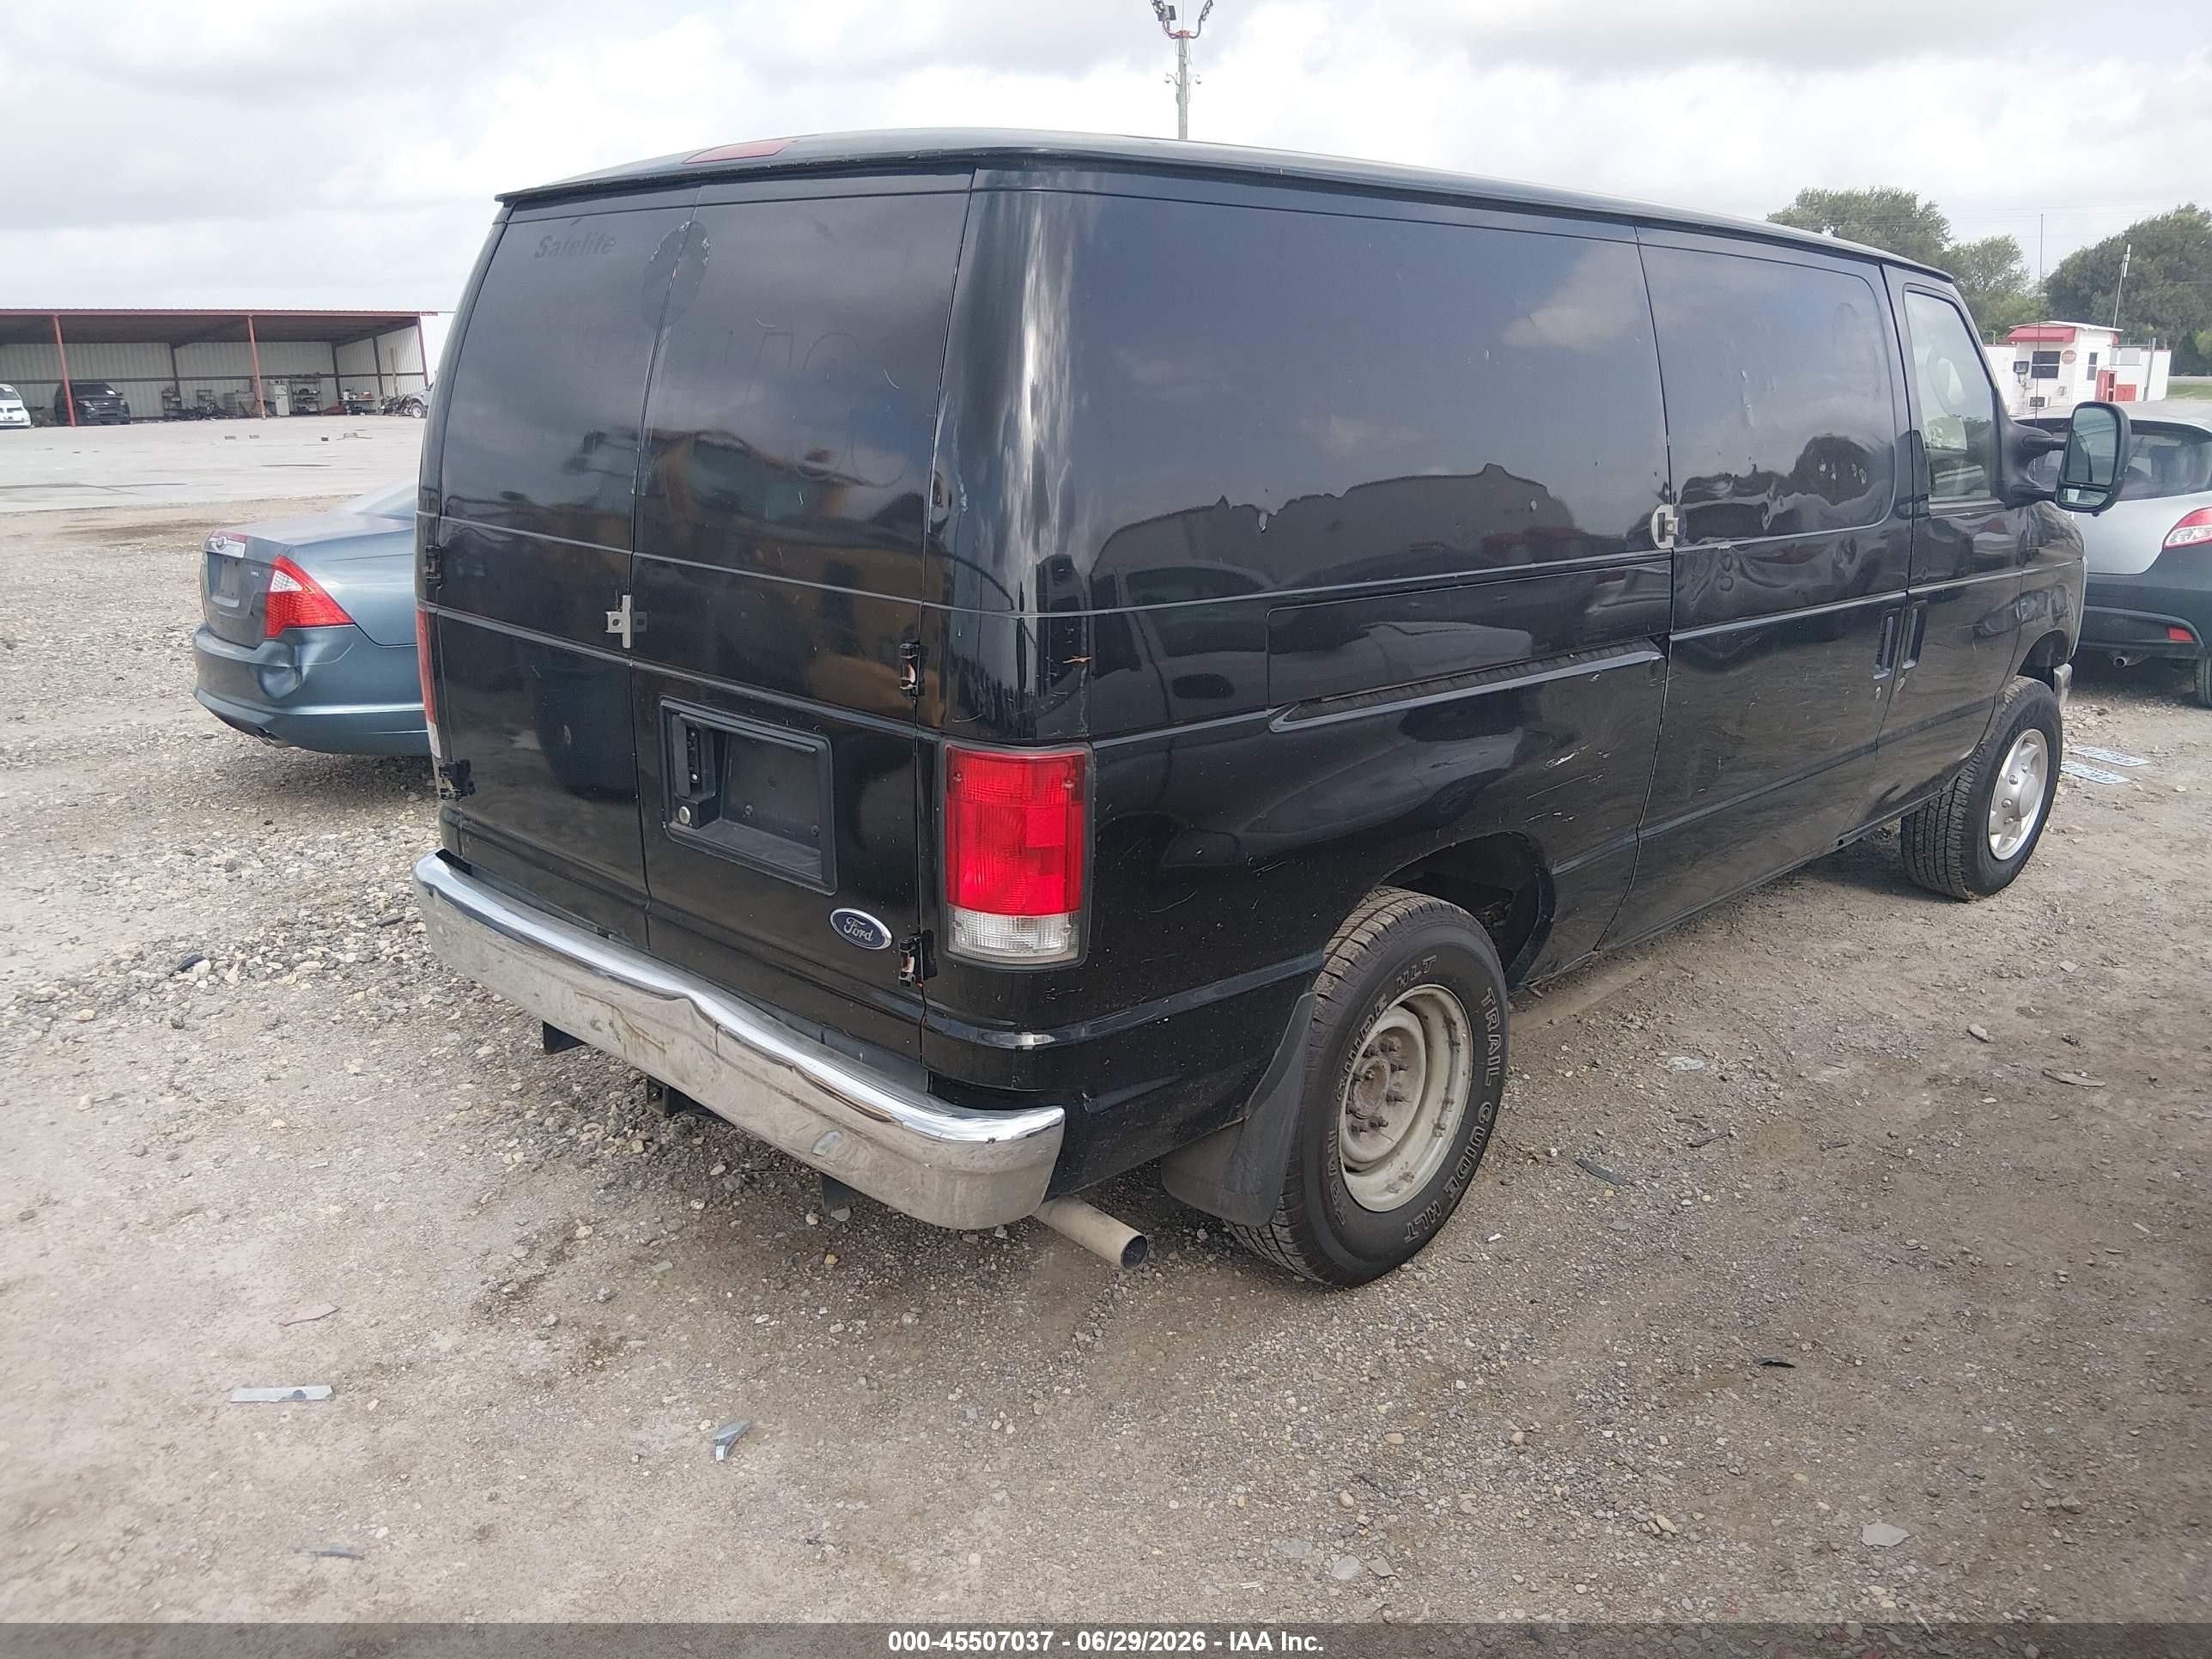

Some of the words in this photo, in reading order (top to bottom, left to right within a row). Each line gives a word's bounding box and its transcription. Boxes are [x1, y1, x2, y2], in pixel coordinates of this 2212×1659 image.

[534, 232, 616, 258] Satelite
[844, 917, 873, 941] Ford
[1396, 955, 1437, 994] HLT
[1480, 987, 1502, 1087] TRAIL
[1443, 1102, 1492, 1200] GUIDE
[1404, 1200, 1442, 1243] HLT
